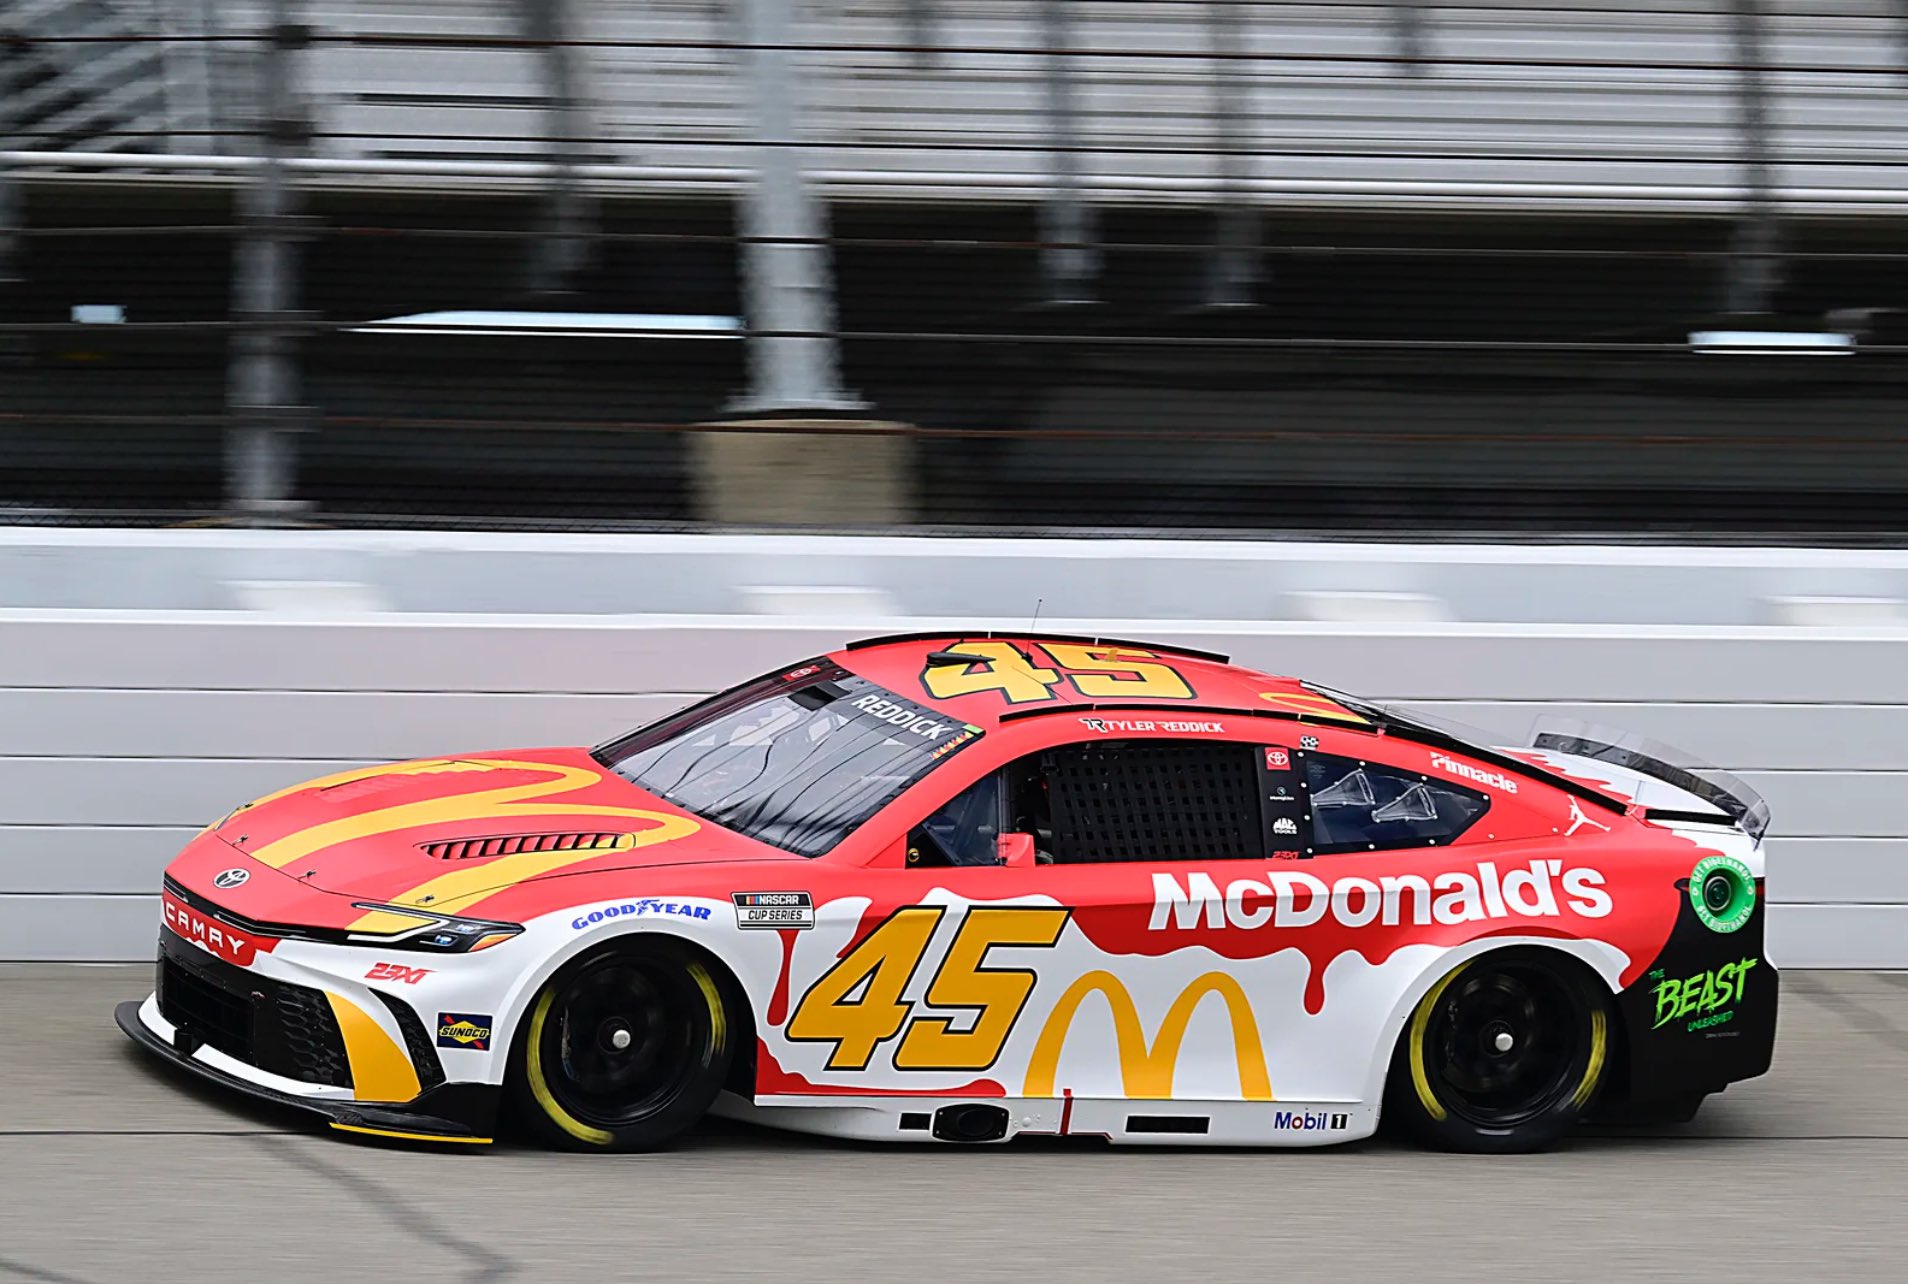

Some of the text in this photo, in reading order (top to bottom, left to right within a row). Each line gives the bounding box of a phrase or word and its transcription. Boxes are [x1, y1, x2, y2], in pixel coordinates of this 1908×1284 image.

[919, 641, 1197, 705] 45
[851, 694, 953, 740] REDDICK
[1105, 720, 1156, 731] TYLER
[1156, 721, 1225, 733] REDDICK
[1430, 751, 1518, 794] Pinnacle
[748, 910, 803, 920] CUP SERIES
[759, 895, 799, 905] NASCAR
[1148, 859, 1613, 930] McDonald's
[165, 901, 245, 955] CAMRY
[784, 905, 1075, 1071] 45
[1648, 957, 1758, 1030] BEAST
[441, 1026, 489, 1039] SUNOCO
[1274, 1112, 1346, 1130] Mobil 1
